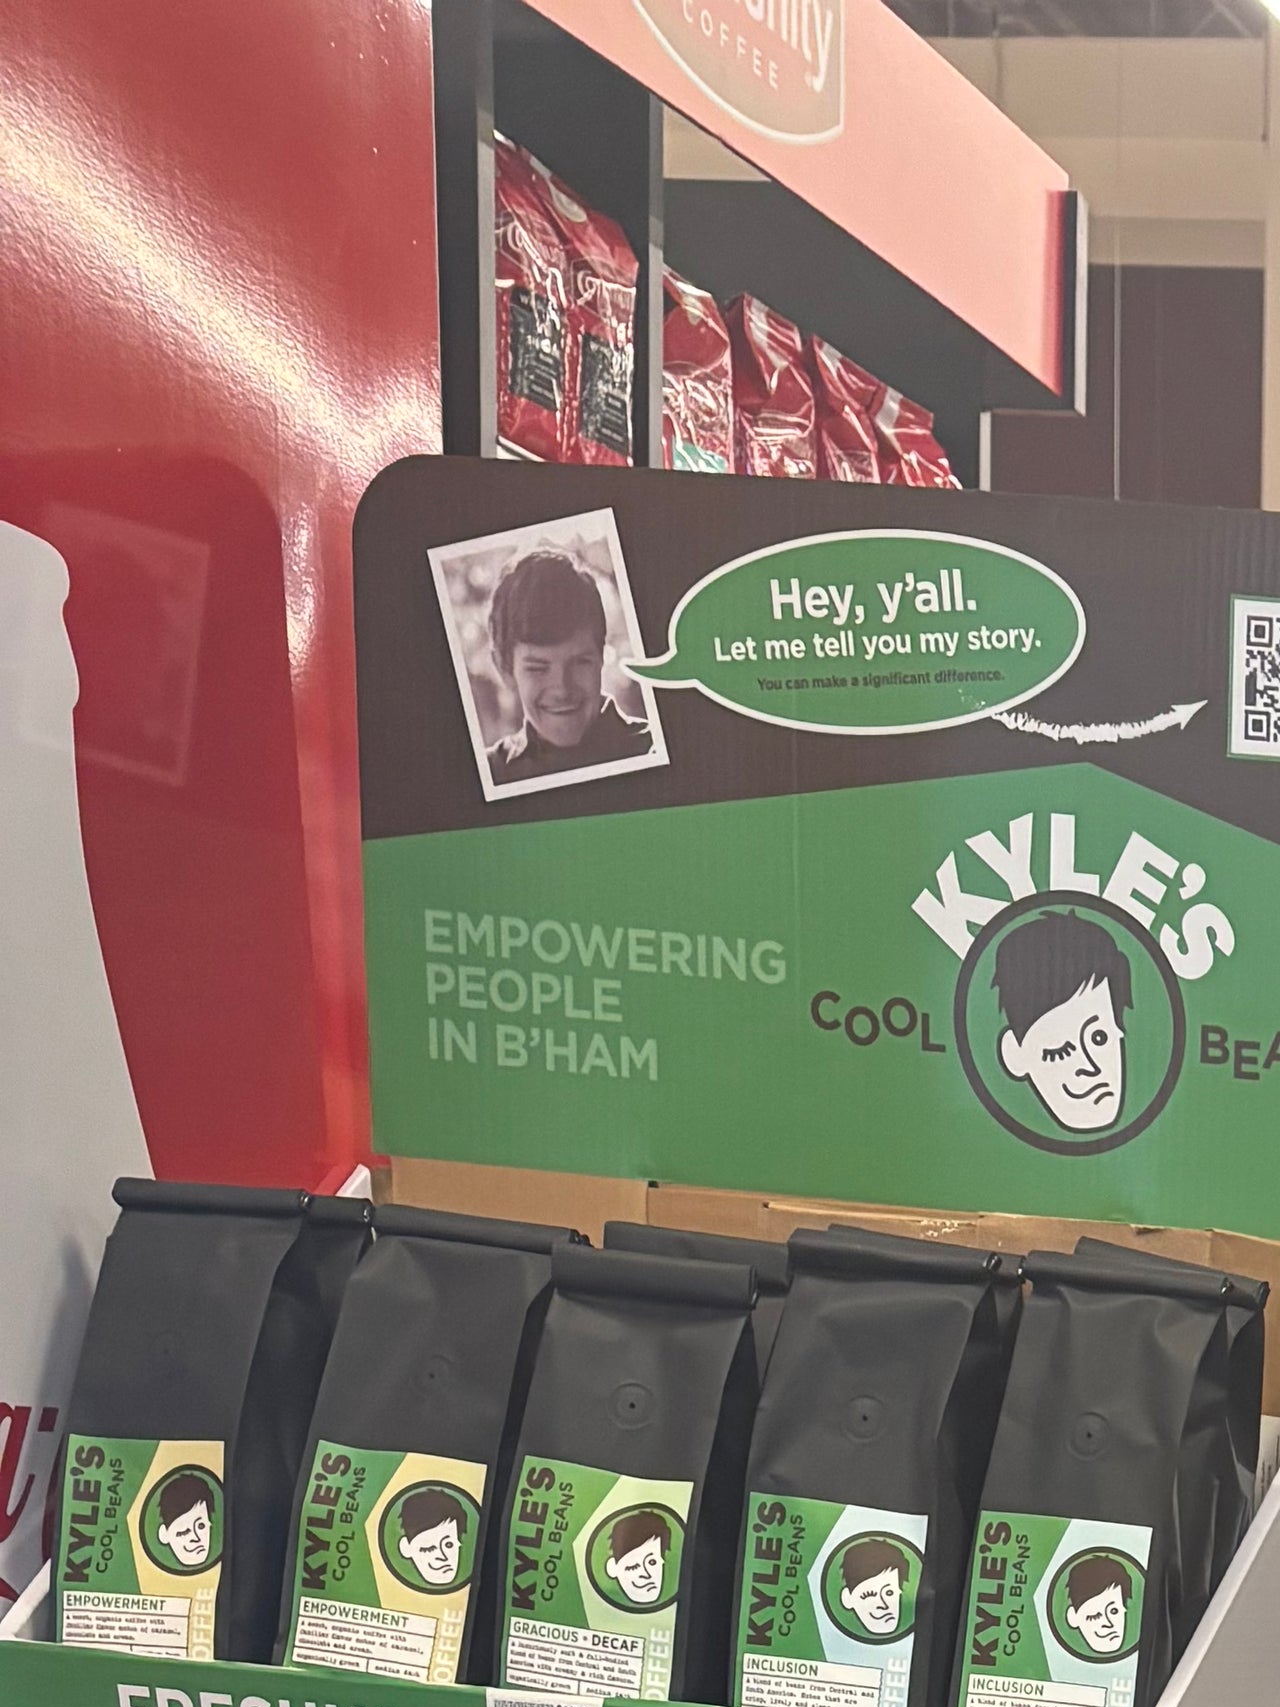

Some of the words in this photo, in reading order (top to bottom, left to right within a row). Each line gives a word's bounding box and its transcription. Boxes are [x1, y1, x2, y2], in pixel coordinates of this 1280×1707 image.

[682, 0, 778, 90] COFFEE
[770, 579, 865, 625] Hey,
[877, 569, 977, 623] y'all.
[713, 637, 757, 661] Let
[765, 639, 806, 660] me
[813, 630, 855, 658] tell
[862, 634, 911, 660] you
[919, 632, 959, 656] my
[967, 626, 1041, 652] story.
[757, 678, 782, 691] You
[785, 677, 809, 689] can
[812, 675, 847, 688] make
[851, 676, 859, 686] a
[862, 671, 931, 688] significant
[935, 669, 1005, 684] difference.
[910, 812, 1235, 981] KYLE'S
[424, 909, 787, 985] EMPOWERING
[425, 962, 623, 1023] PEOPLE
[811, 990, 946, 1054] COOL
[427, 1017, 478, 1065] IN
[495, 1024, 659, 1083] B'HAM
[62, 1444, 106, 1583] KYLE'S
[104, 1457, 124, 1519] BEANS
[340, 1465, 366, 1524] BEANS
[550, 1481, 574, 1542] BEANS
[95, 1524, 119, 1575] COOL
[302, 1452, 352, 1590] KYLE'S
[512, 1465, 557, 1611] KYLE'S
[784, 1514, 804, 1579] BEANS
[331, 1529, 356, 1582] COOL
[540, 1550, 562, 1602] COOL
[745, 1501, 787, 1647] KYLE'S
[1010, 1532, 1030, 1598] BEANS
[66, 1594, 166, 1611] EMPOWERMENT
[303, 1601, 409, 1628] EMPOWERMENT
[777, 1583, 800, 1637] COOL
[970, 1520, 1012, 1668] KYLE'S
[513, 1621, 579, 1642] GRACIOUS
[591, 1634, 639, 1652] DECAF
[1003, 1604, 1025, 1657] COOL
[747, 1658, 819, 1676] INCLUSION
[972, 1678, 1044, 1696] INCLUSION
